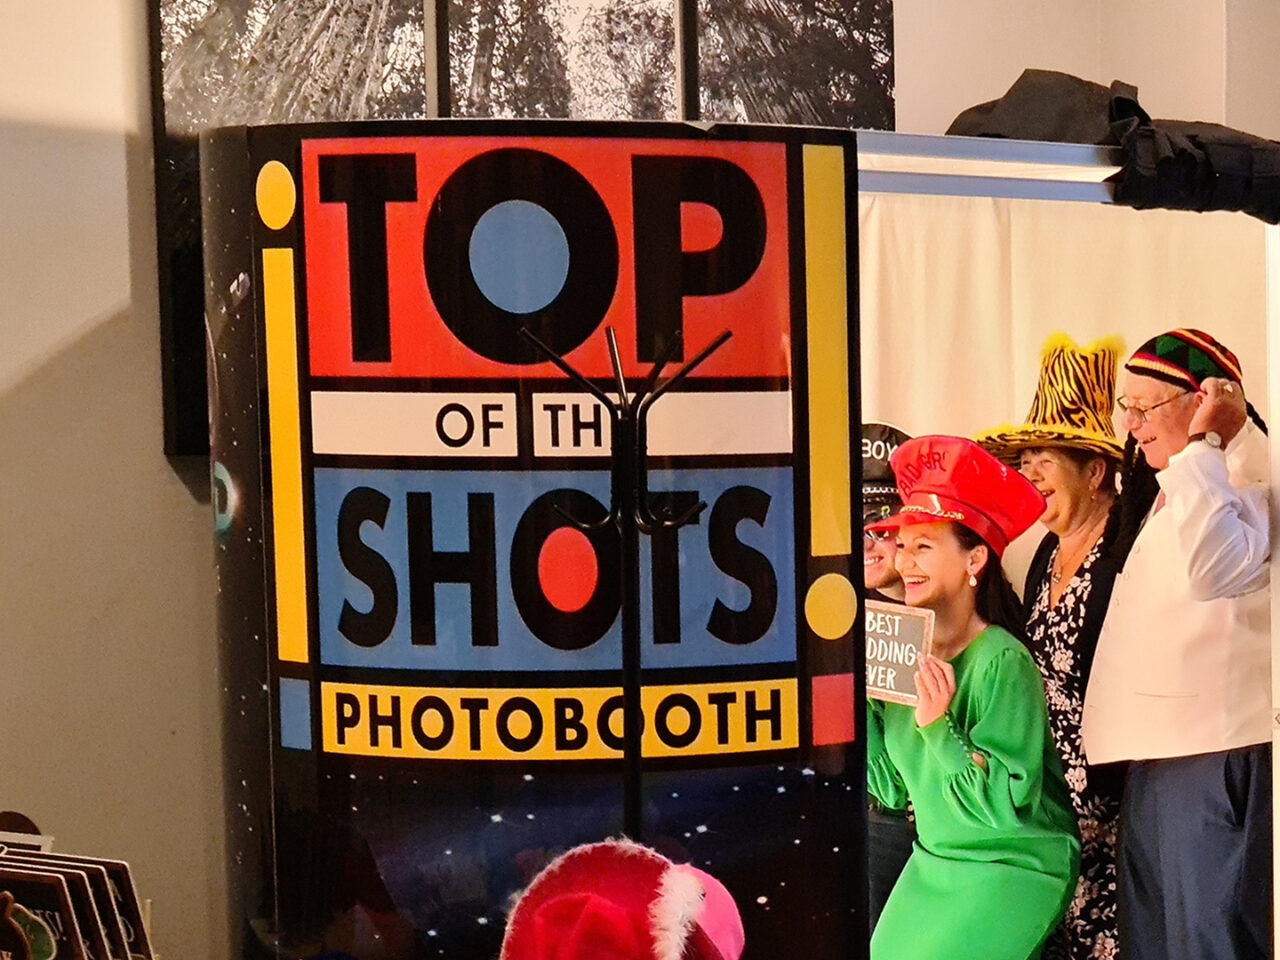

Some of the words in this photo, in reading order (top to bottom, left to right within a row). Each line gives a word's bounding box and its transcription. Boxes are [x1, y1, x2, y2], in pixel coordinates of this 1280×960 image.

[318, 147, 768, 366] TOP
[436, 403, 504, 447] OF
[543, 402, 625, 447] TH
[862, 438, 899, 461] BOY
[337, 485, 778, 651] SHOTS
[865, 612, 902, 636] BEST
[866, 637, 916, 666] DDING
[866, 664, 897, 690] VER
[336, 689, 783, 752] PHOTOBOOTH
